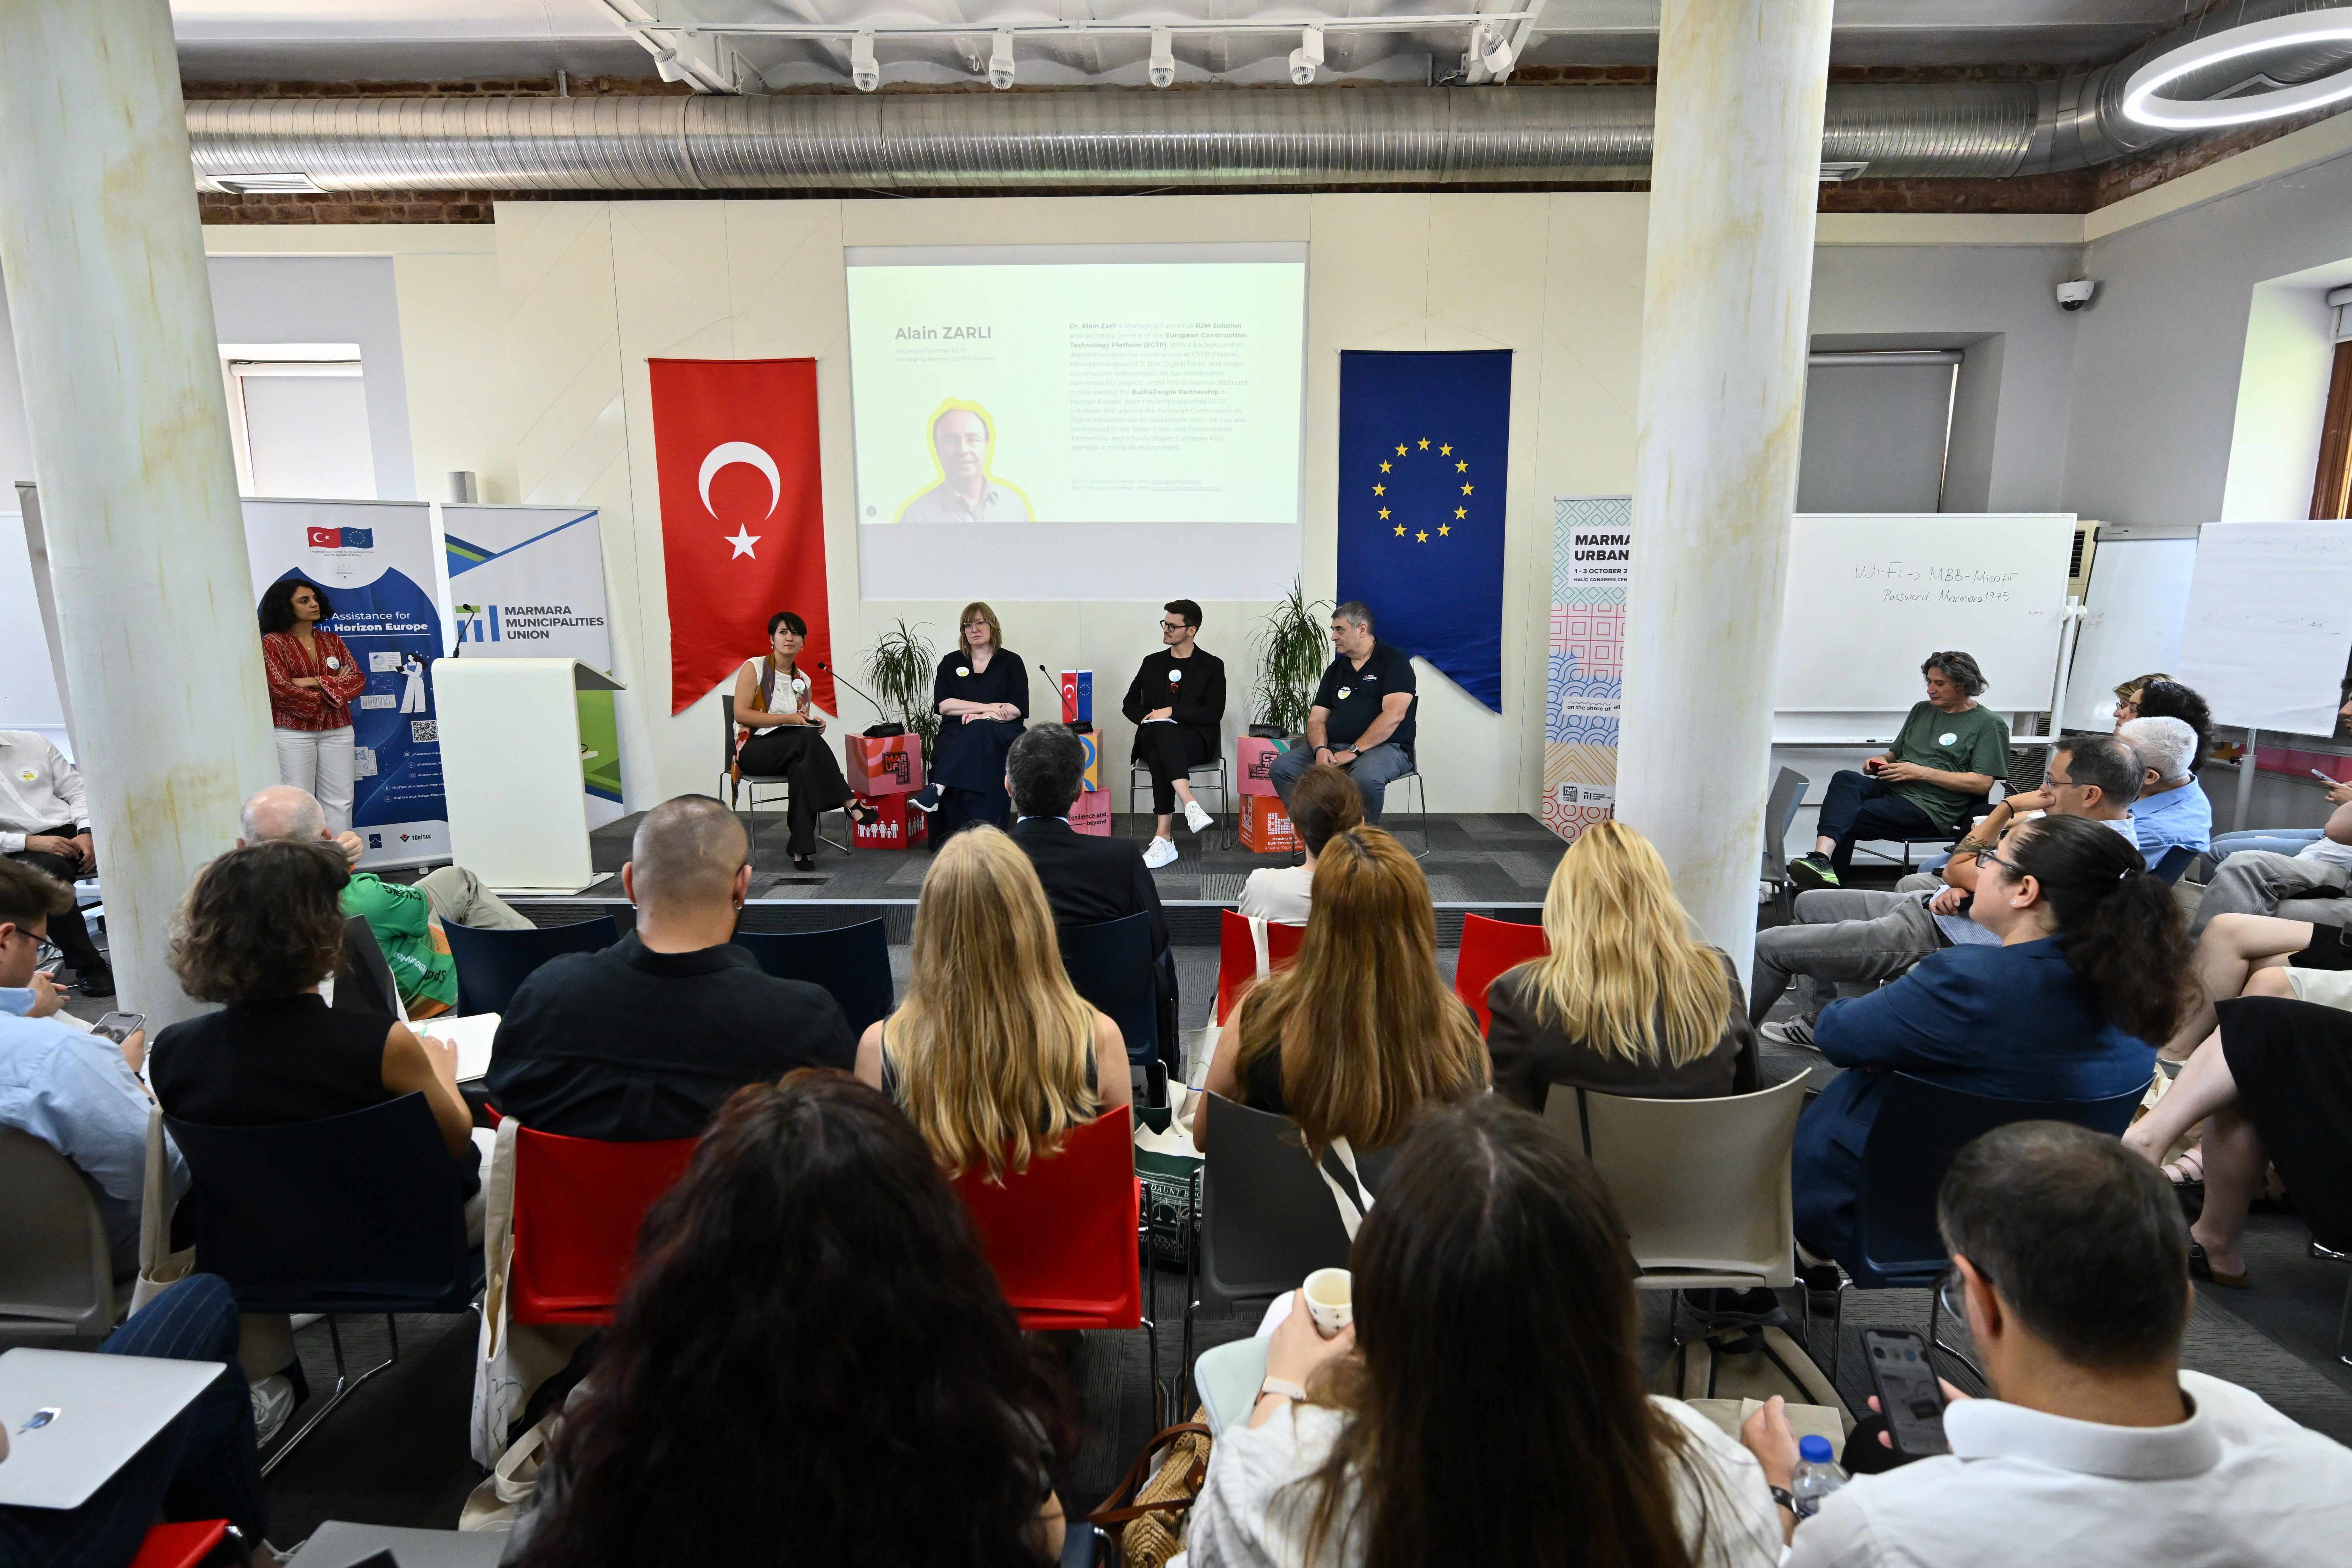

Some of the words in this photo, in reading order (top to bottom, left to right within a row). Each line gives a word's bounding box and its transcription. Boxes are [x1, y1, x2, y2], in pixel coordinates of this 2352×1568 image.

[895, 326, 937, 340] Alain
[942, 326, 991, 339] ZARLI
[1575, 535, 1630, 545] MARMA
[1575, 550, 1629, 561] URBAN
[1855, 562, 1902, 579] Wi-Fi
[505, 606, 572, 615] MARMARA
[332, 612, 392, 620] Assistance
[335, 623, 382, 632] Horizon
[386, 623, 428, 631] Europe
[506, 617, 604, 628] MUNICIPALITIES
[507, 630, 549, 640] UNION
[885, 754, 907, 763] MAR
[885, 763, 898, 771] UF
[1151, 1184, 1181, 1196] DAUNT
